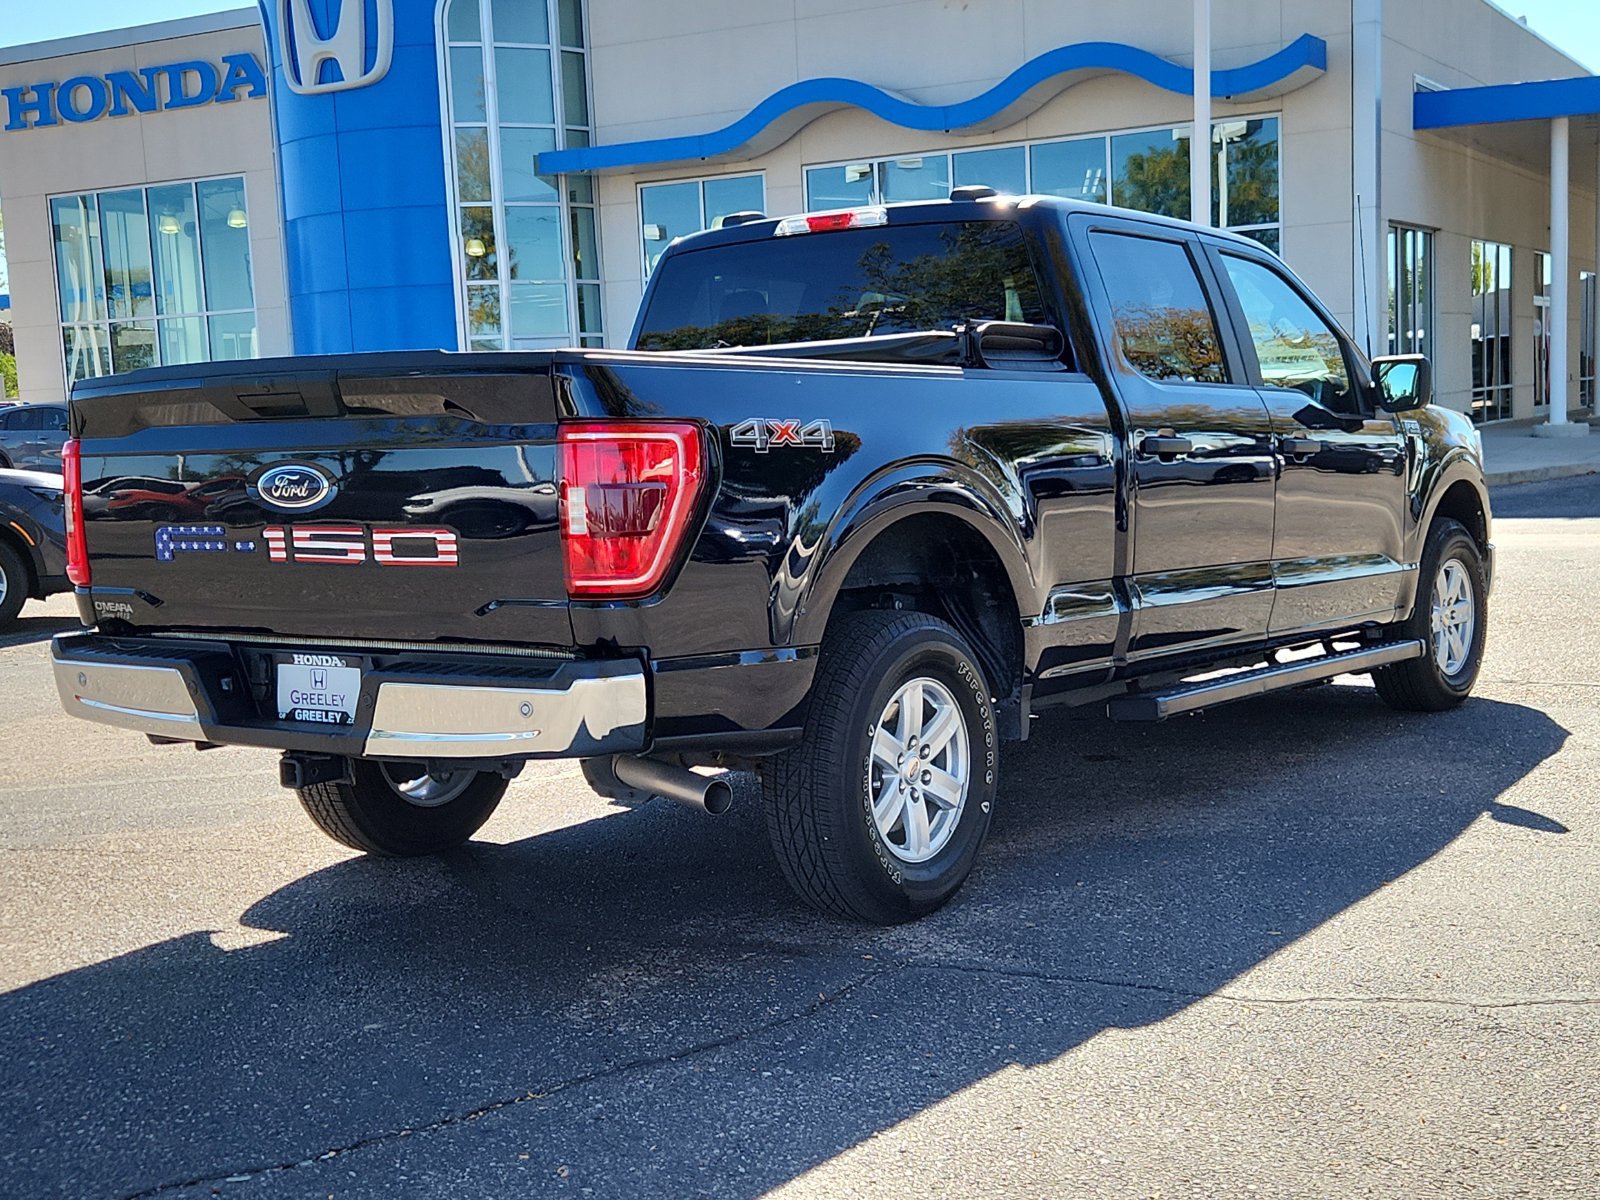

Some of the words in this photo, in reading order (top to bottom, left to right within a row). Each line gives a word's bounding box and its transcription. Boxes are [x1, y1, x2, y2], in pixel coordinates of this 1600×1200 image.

[1, 52, 269, 132] HONDA
[271, 474, 310, 497] Ford
[154, 525, 458, 567] F-150
[292, 654, 342, 667] HONDA
[290, 689, 346, 707] GREELEY
[294, 709, 342, 723] GREELEY
